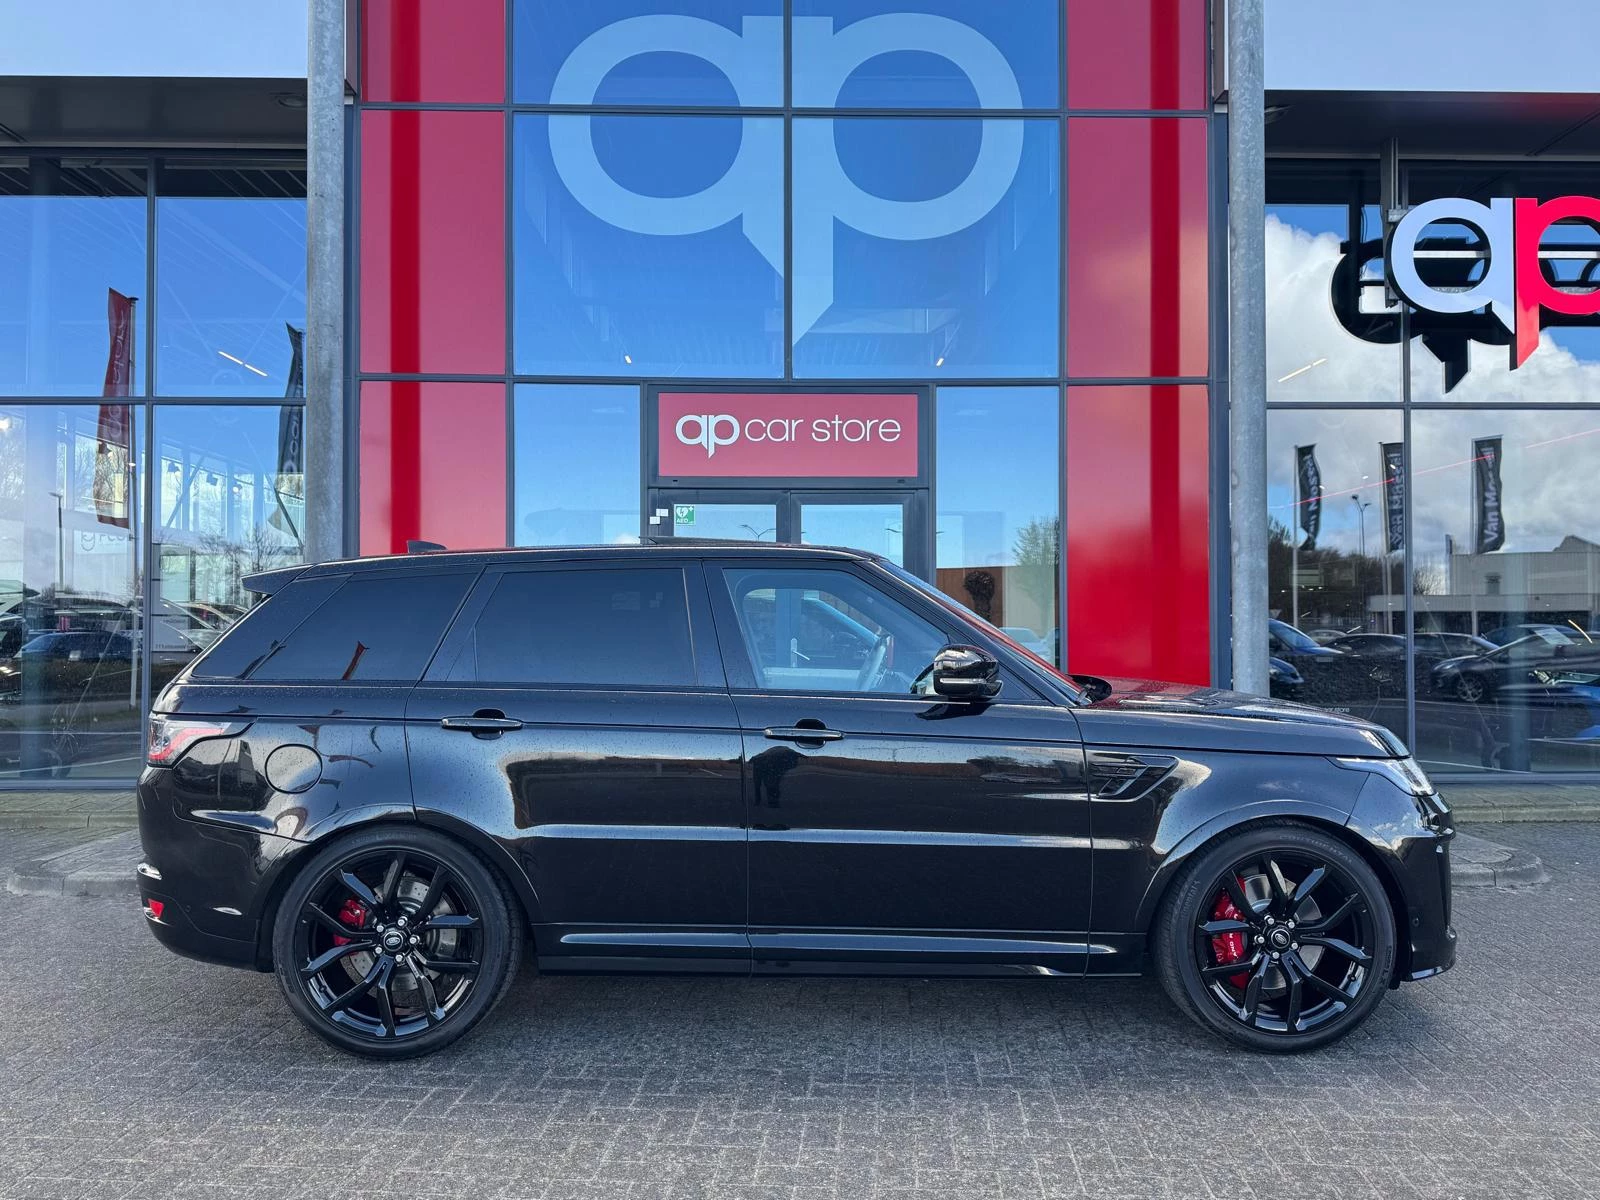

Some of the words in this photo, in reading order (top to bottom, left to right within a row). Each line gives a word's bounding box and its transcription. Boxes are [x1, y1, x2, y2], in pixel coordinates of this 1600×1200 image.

[744, 418, 804, 442] car
[811, 414, 901, 442] store
[1483, 512, 1499, 543] Van
